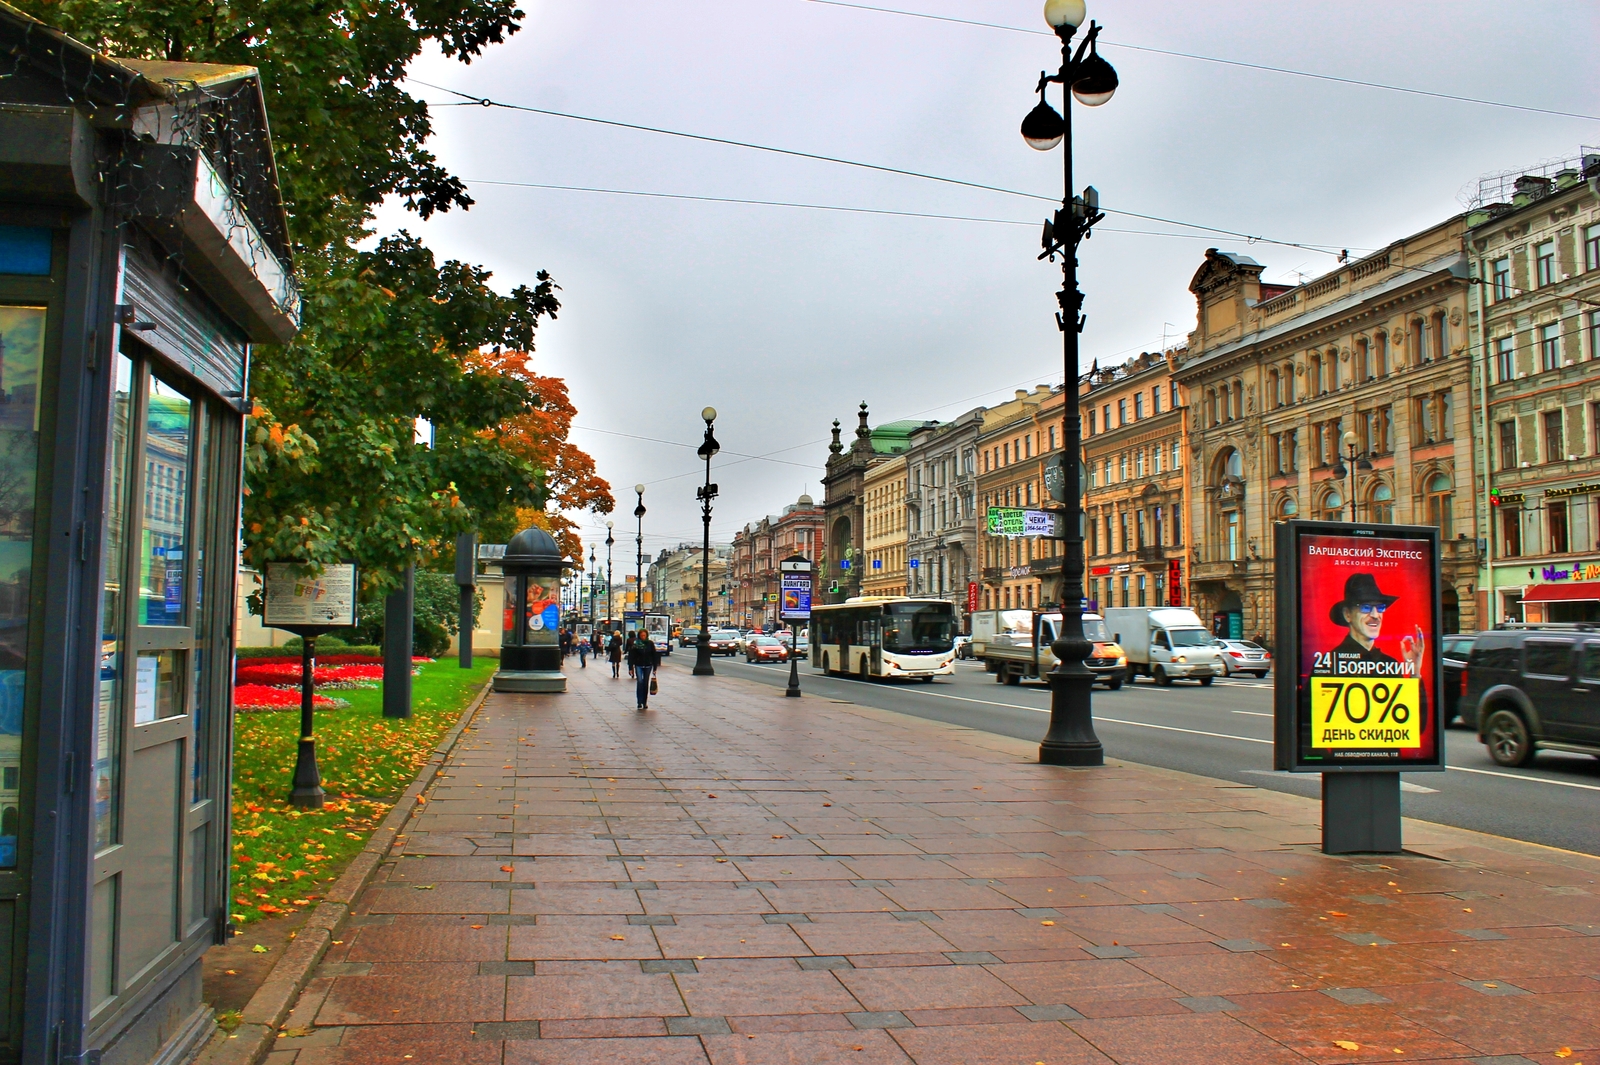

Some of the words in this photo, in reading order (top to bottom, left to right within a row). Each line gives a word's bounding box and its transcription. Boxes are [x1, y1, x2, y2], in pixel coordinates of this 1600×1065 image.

[1003, 518, 1024, 526] ОТЕЛЬ
[1313, 651, 1332, 668] 24
[1338, 658, 1415, 675] БОЯРСКИЙ
[1320, 682, 1410, 724] 70%
[1322, 728, 1356, 743] ДЕНЬ
[1359, 728, 1410, 743] СКИДОК
